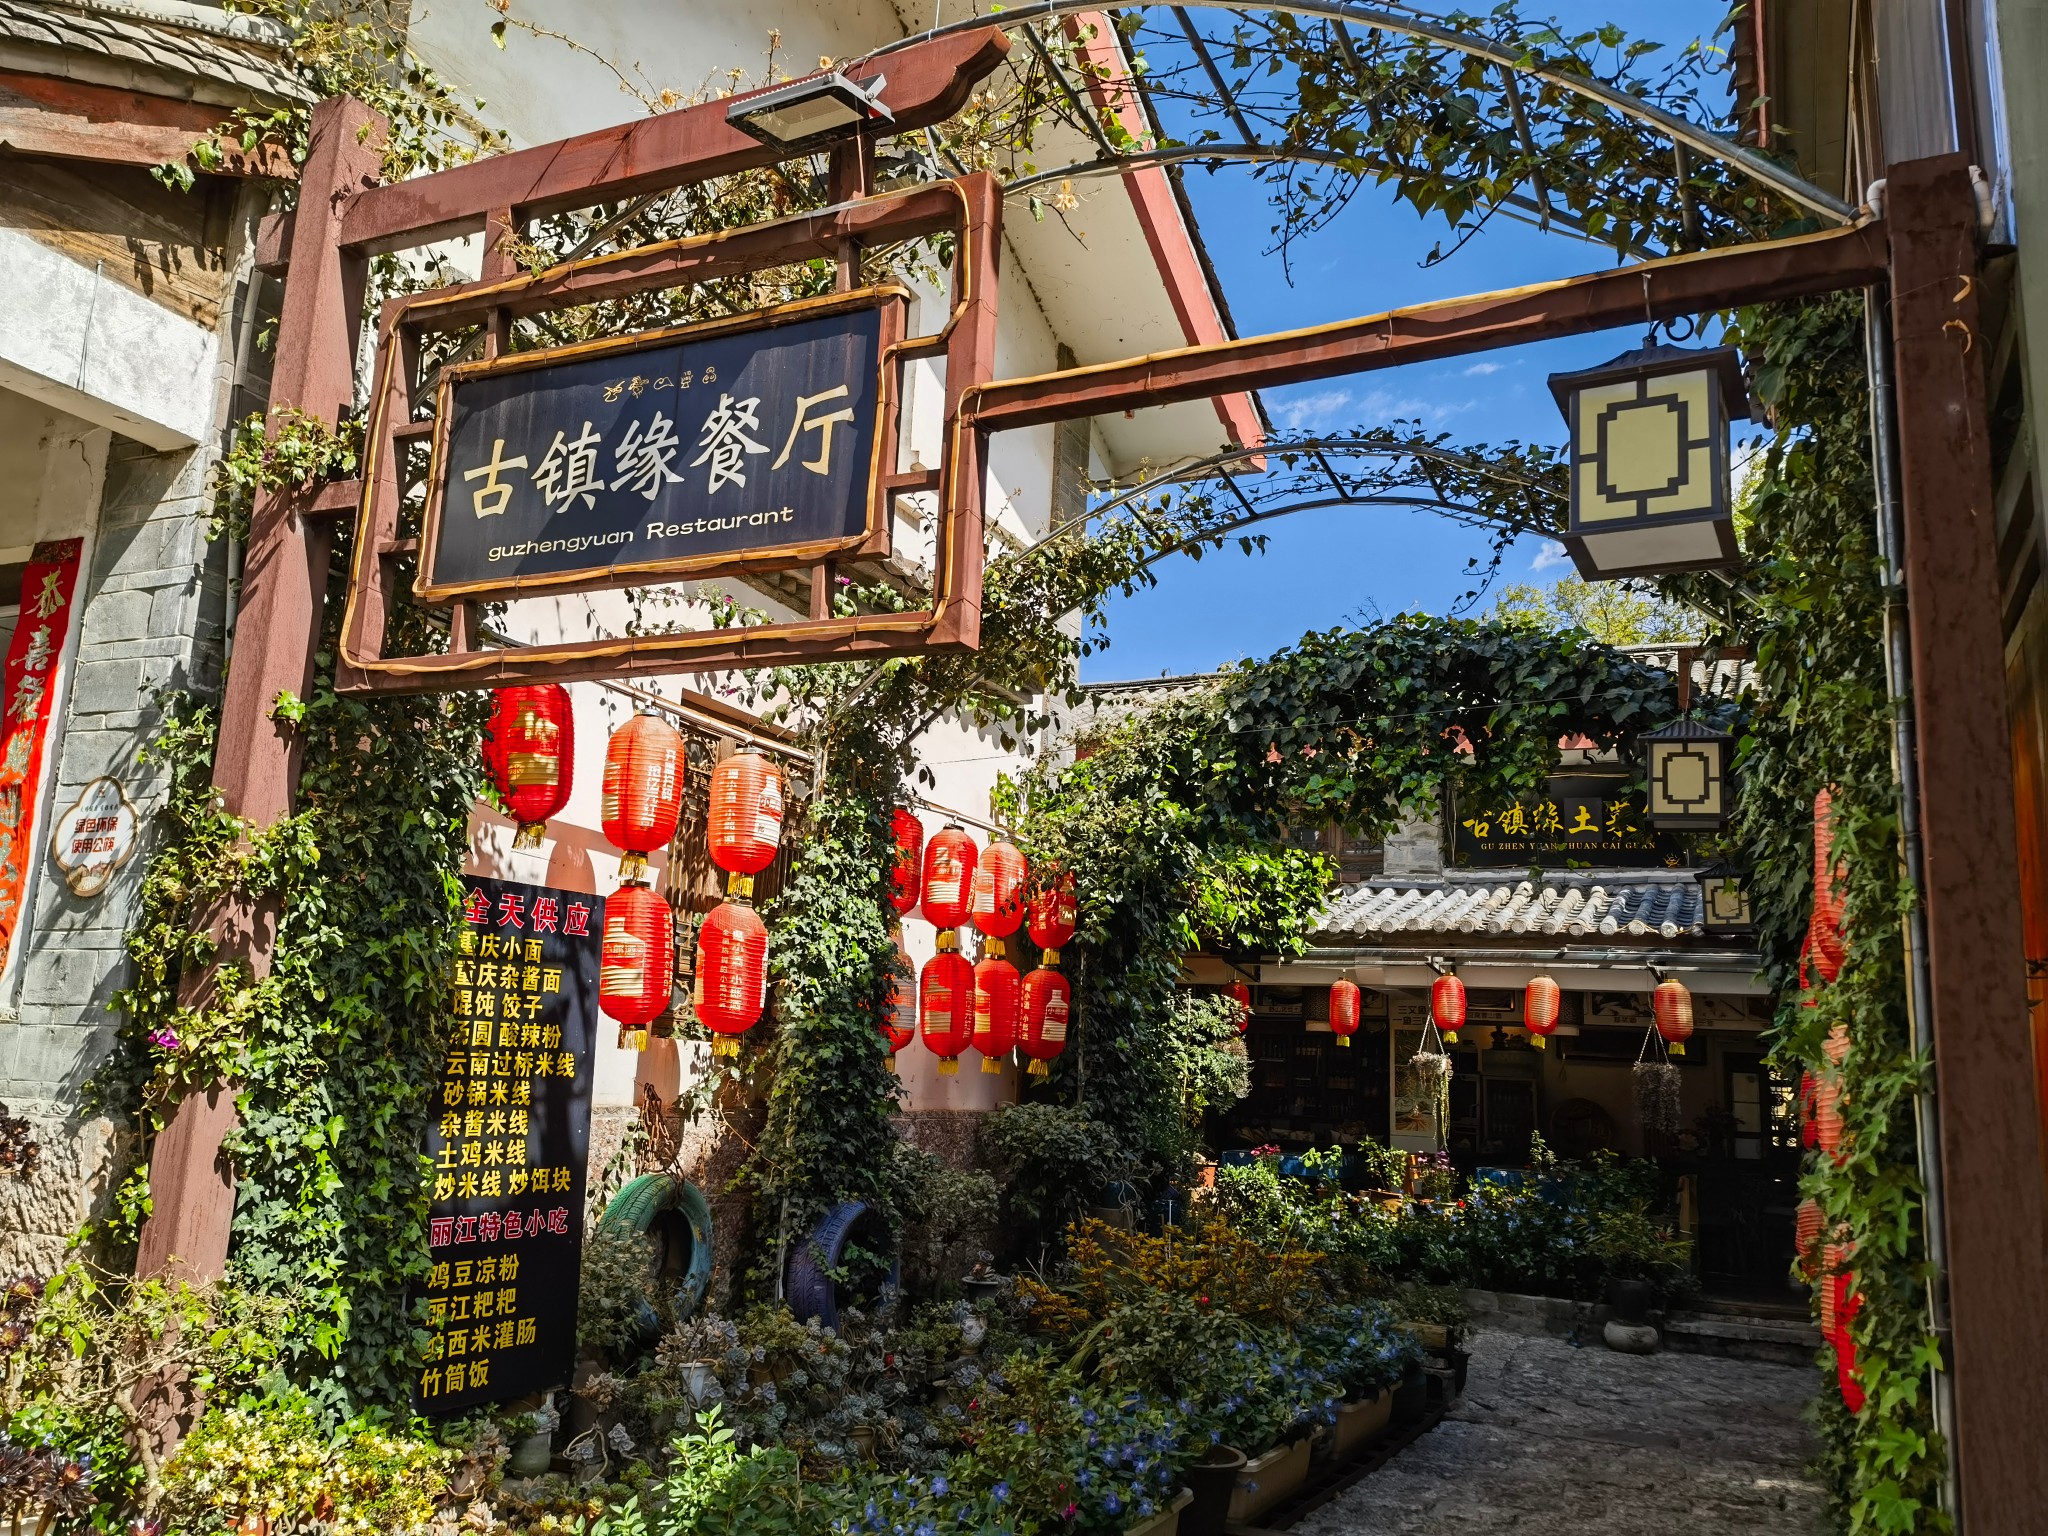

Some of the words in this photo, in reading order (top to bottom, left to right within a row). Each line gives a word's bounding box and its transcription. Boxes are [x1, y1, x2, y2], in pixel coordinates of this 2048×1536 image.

[464, 384, 855, 519] 古镇缘餐厅
[488, 529, 634, 562] guzhengyuan
[646, 506, 794, 540] Restaurant
[74, 816, 119, 834] 绿色环保
[71, 836, 115, 854] 使用公筷
[1480, 842, 1495, 850] GU
[1498, 842, 1525, 850] ZHEN
[1562, 842, 1600, 850] HUAN
[1602, 842, 1621, 850] CAI
[463, 887, 591, 937] 全天供应
[458, 931, 544, 964] 重庆小面
[454, 960, 562, 993] 重庆杂酱面
[453, 990, 495, 1017] 馄饨
[502, 993, 543, 1020] 饺子
[498, 1022, 561, 1049] 酸辣粉
[446, 1051, 576, 1078] 云南过桥米线
[443, 1080, 531, 1106] 砂锅米线
[439, 1109, 529, 1138] 杂酱米线
[436, 1139, 526, 1169] 土鸡米线
[433, 1170, 501, 1201] 炒米线
[508, 1166, 572, 1196] 炒饵块
[430, 1206, 569, 1248] 丽江特色小吃
[428, 1253, 520, 1290] 鸡豆凉粉
[425, 1287, 517, 1326] 丽江粑粑
[420, 1358, 490, 1398] 竹筒饭
